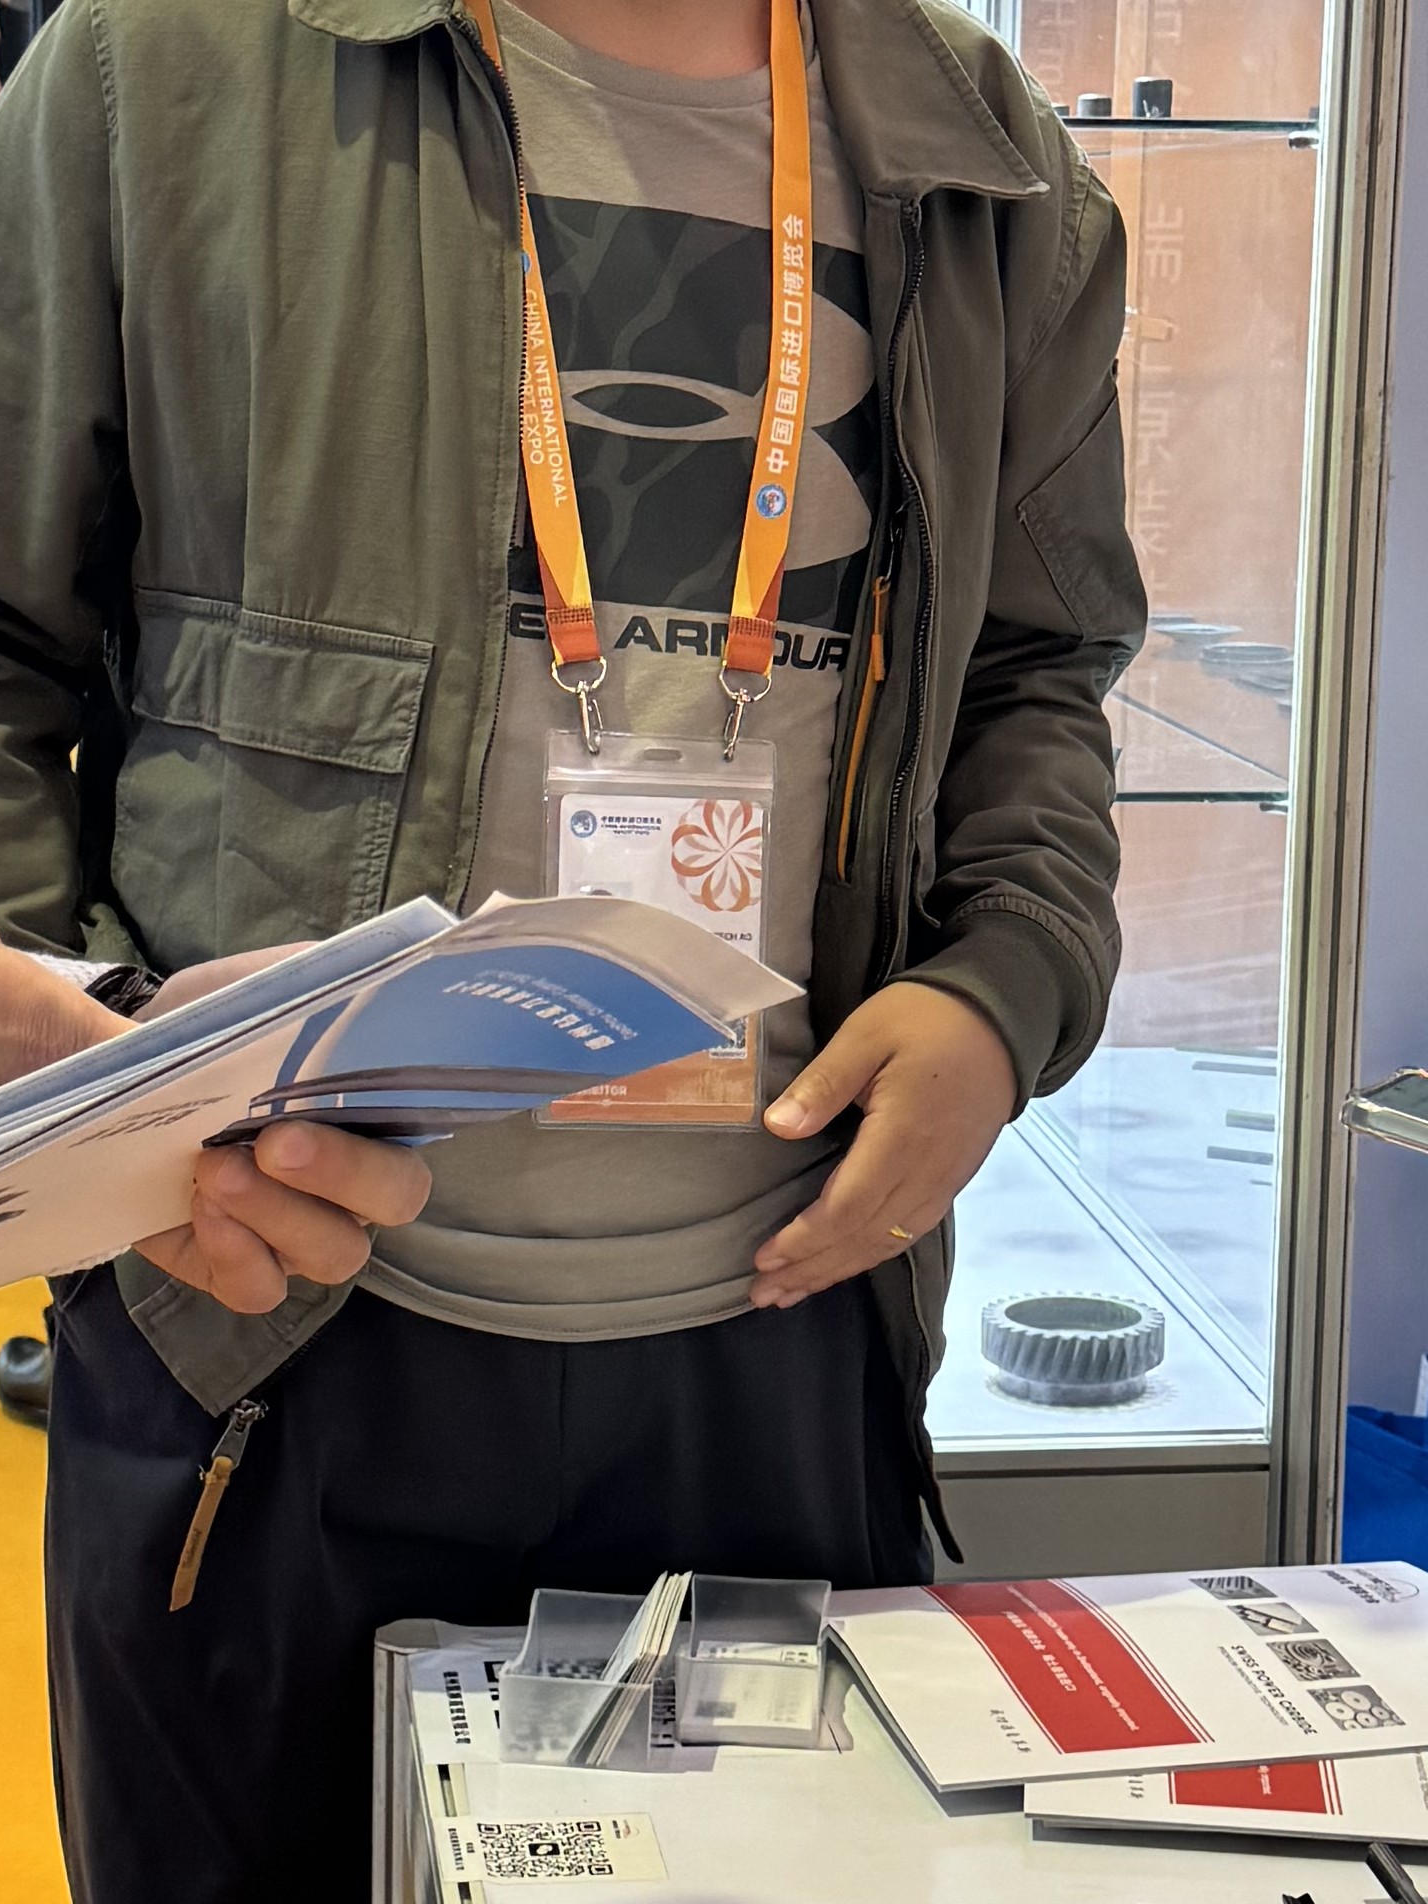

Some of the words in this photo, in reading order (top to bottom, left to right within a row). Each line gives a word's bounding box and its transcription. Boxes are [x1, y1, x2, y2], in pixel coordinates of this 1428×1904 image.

[526, 288, 544, 346] CHINA
[767, 214, 805, 474] 中国国际进口博览会
[525, 413, 545, 465] EXPO
[533, 355, 568, 508] INTERNATIONAL
[1231, 1643, 1259, 1669] SWISS
[1253, 1669, 1285, 1701] POWER
[1279, 1698, 1318, 1736] CARBIDE
